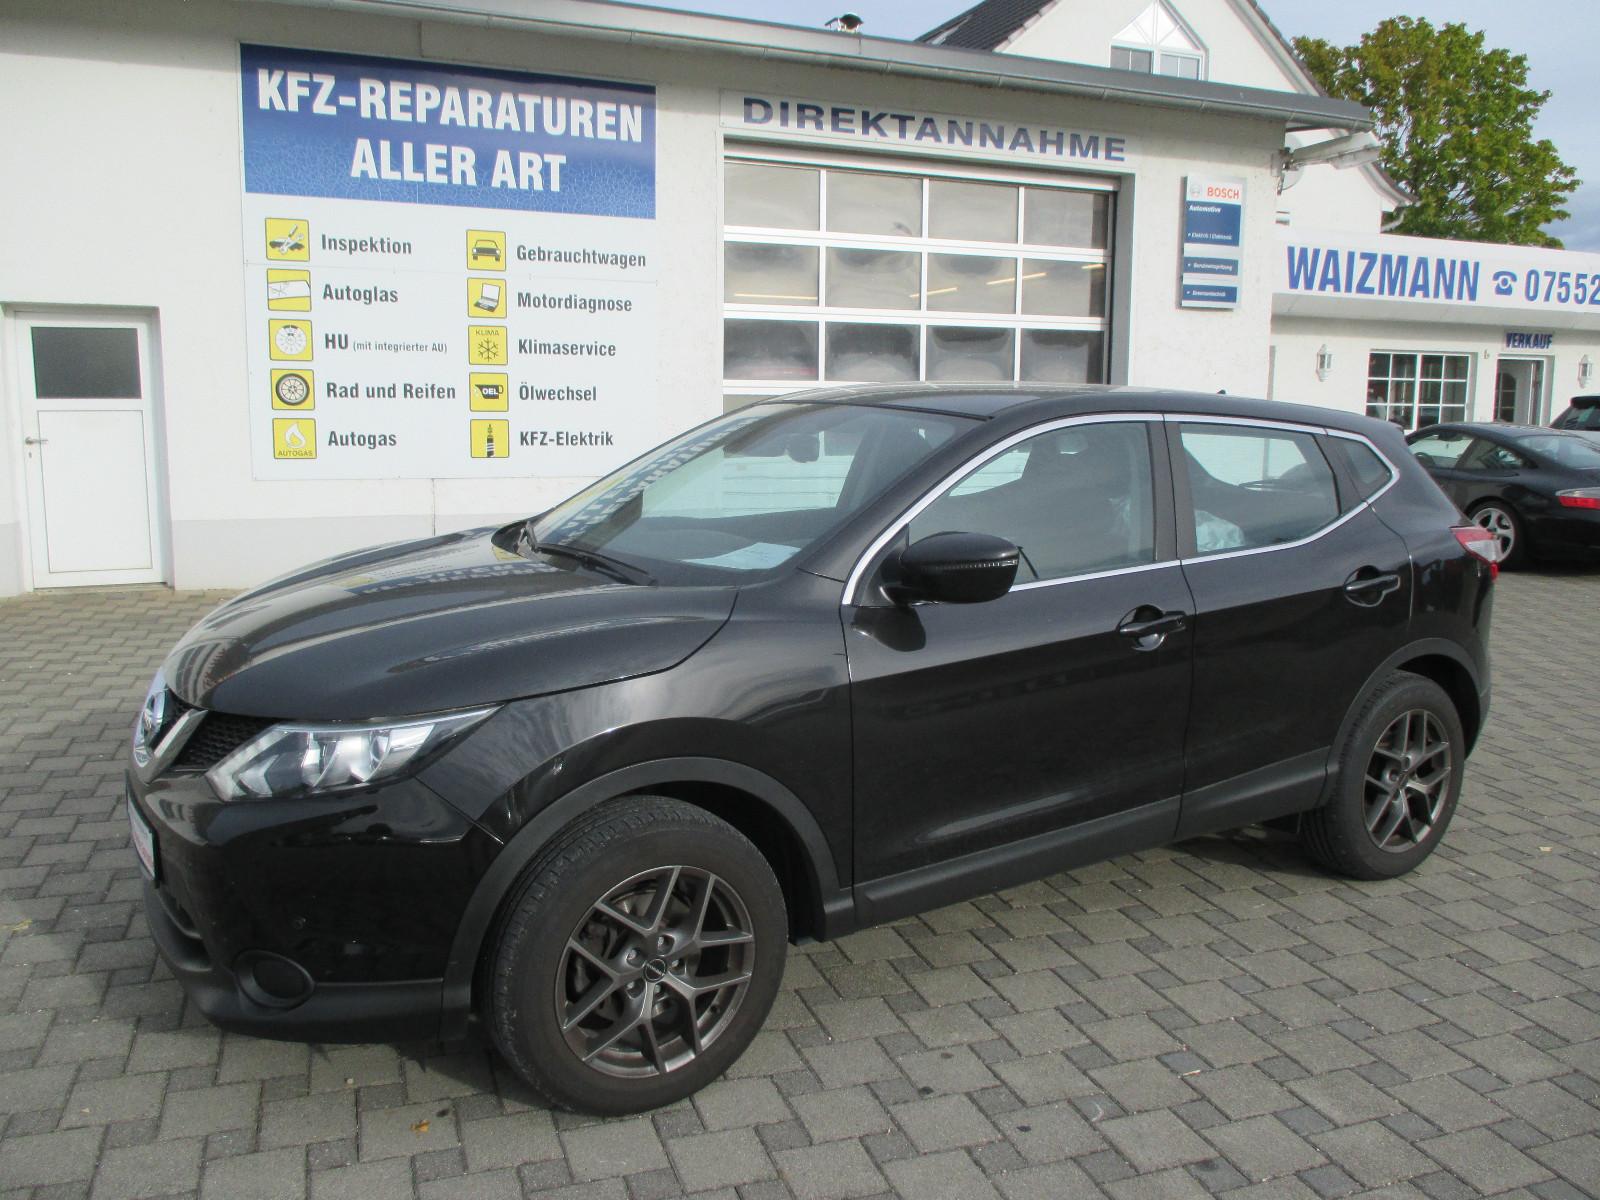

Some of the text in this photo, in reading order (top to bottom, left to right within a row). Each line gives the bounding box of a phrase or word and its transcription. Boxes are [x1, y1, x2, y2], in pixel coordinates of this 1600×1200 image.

[257, 68, 642, 142] KFZ-REPARATUREN
[743, 97, 1126, 162] DIREKTANNAHME
[351, 137, 567, 193] ALLER ART
[1207, 186, 1240, 200] BOSCH
[321, 233, 413, 256] Inspektion
[516, 244, 647, 270] Gebrauchtwagen
[1287, 246, 1480, 302] WAIZMANN
[322, 283, 399, 306] Autoglas
[1524, 268, 1600, 305] 07552
[517, 292, 633, 314] Motordiagnose
[324, 333, 448, 354] HU (mit integrierter AU)
[475, 329, 500, 337] KLIMA
[1506, 332, 1553, 350] VERKAUF
[518, 338, 617, 357] Klimaservice
[326, 382, 456, 400] Rad und Reifen
[483, 387, 498, 395] OEL
[518, 381, 597, 402] Ölwechsel
[327, 430, 397, 450] Autogas
[519, 430, 614, 447] KFZ-Elektrik
[277, 449, 314, 458] AUTOGAS
